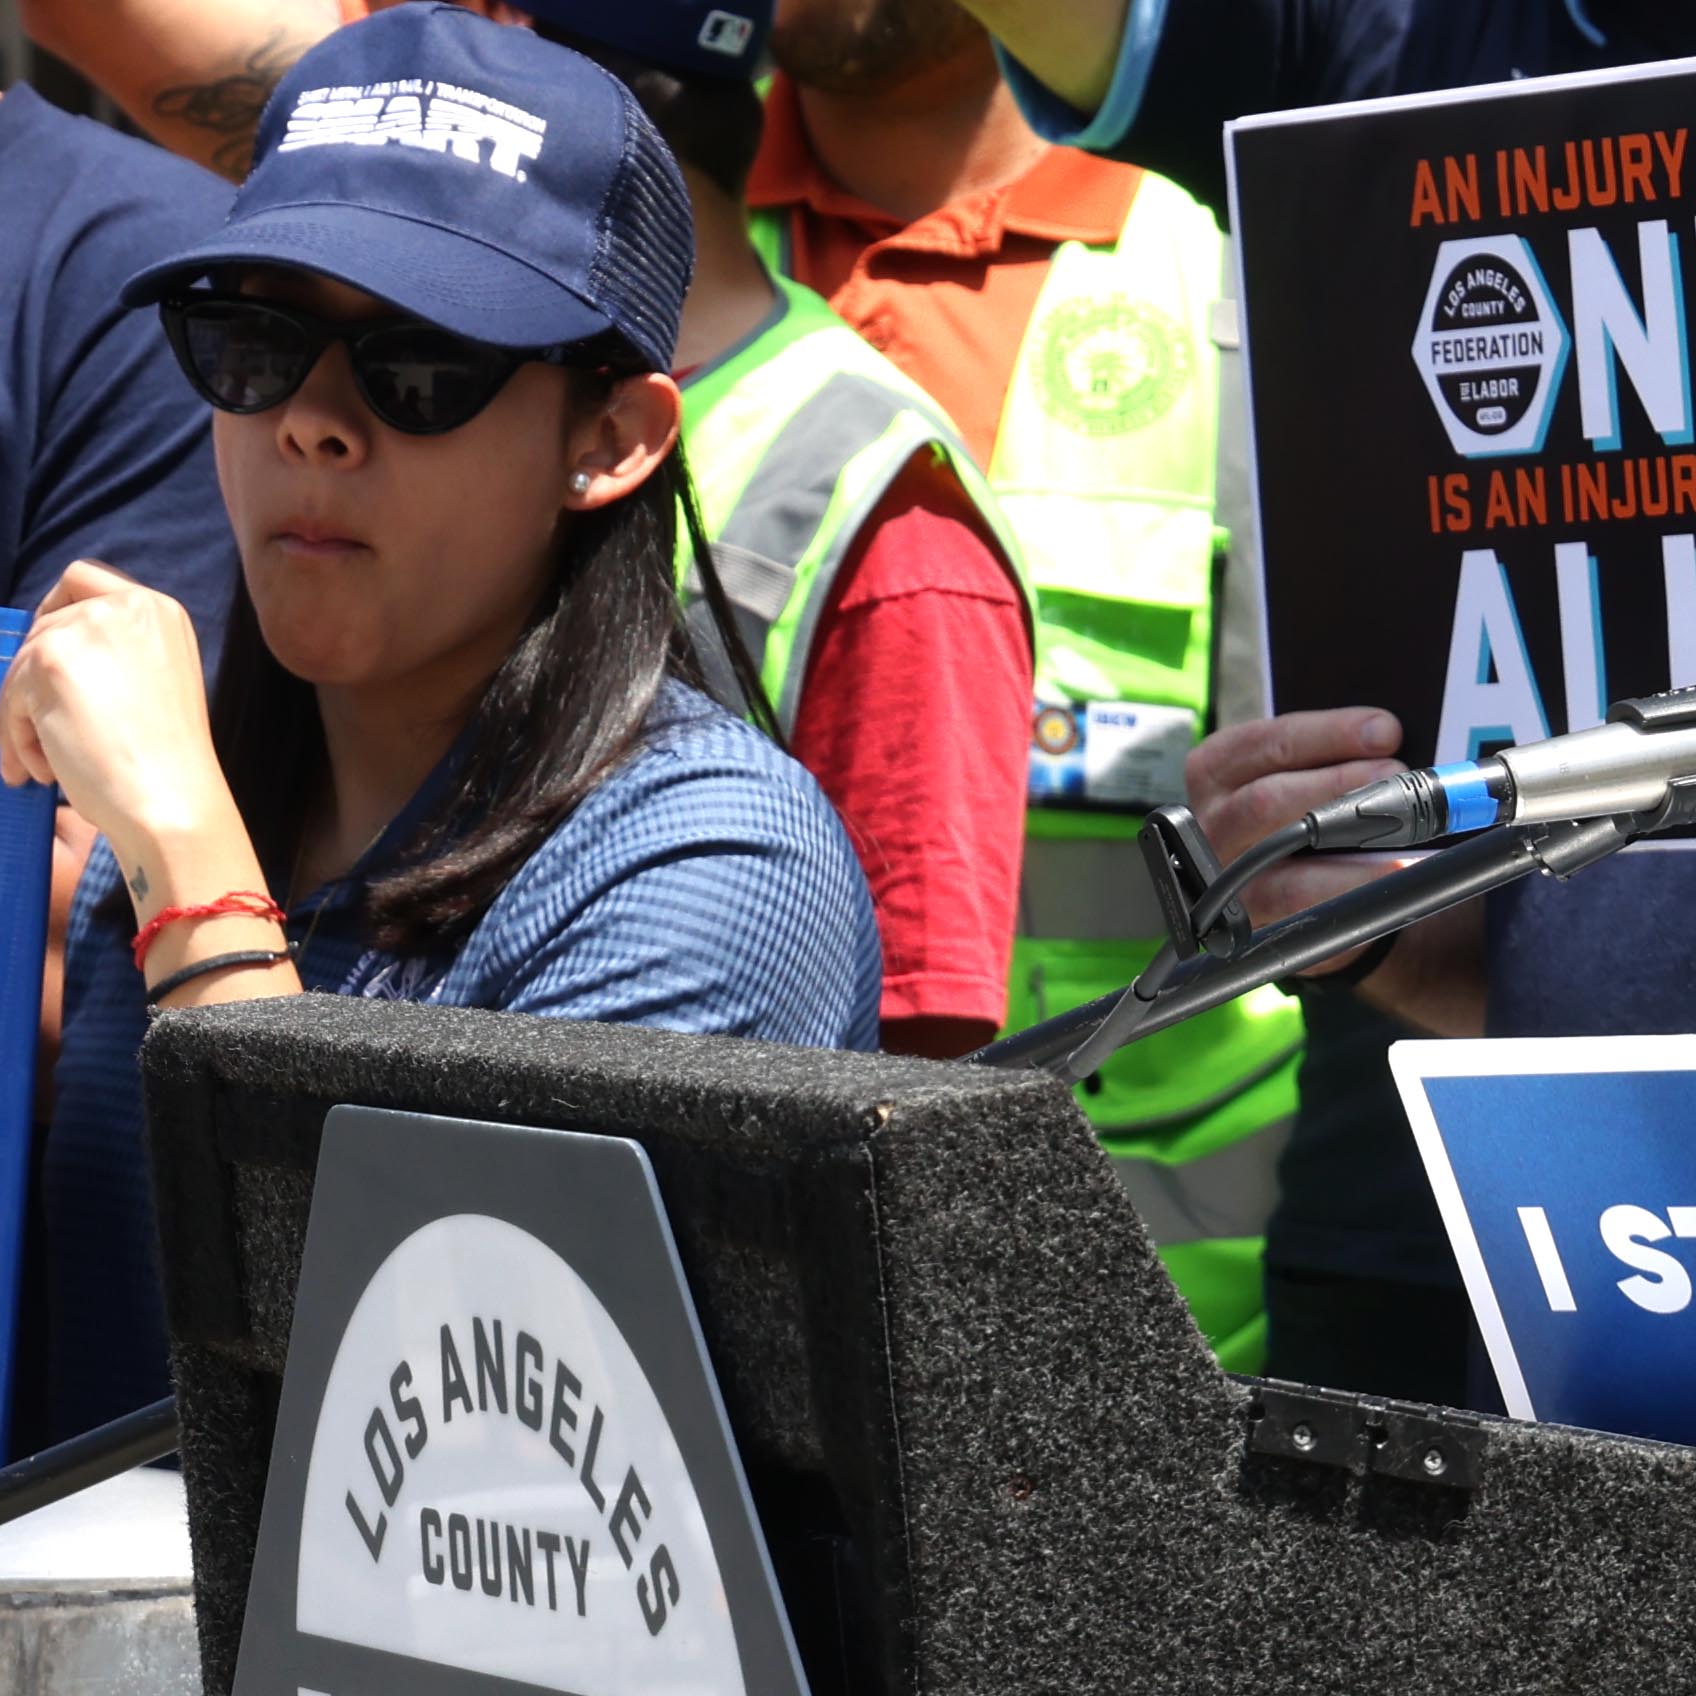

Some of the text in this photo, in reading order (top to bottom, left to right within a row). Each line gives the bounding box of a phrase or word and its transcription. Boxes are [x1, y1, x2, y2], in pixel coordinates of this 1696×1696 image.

[1409, 154, 1482, 229] AN
[1495, 128, 1690, 217] INJURY
[1443, 267, 1528, 320] LOS ANGELES
[1460, 299, 1506, 319] COUNTY
[1430, 330, 1545, 366] FEDERATION
[1471, 377, 1520, 401] LABOR
[1427, 473, 1473, 536] IS
[1484, 466, 1549, 531] AN
[1515, 1205, 1578, 1313] I
[343, 1315, 682, 1638] LOS ANGELES
[419, 1505, 591, 1617] COUNTY
